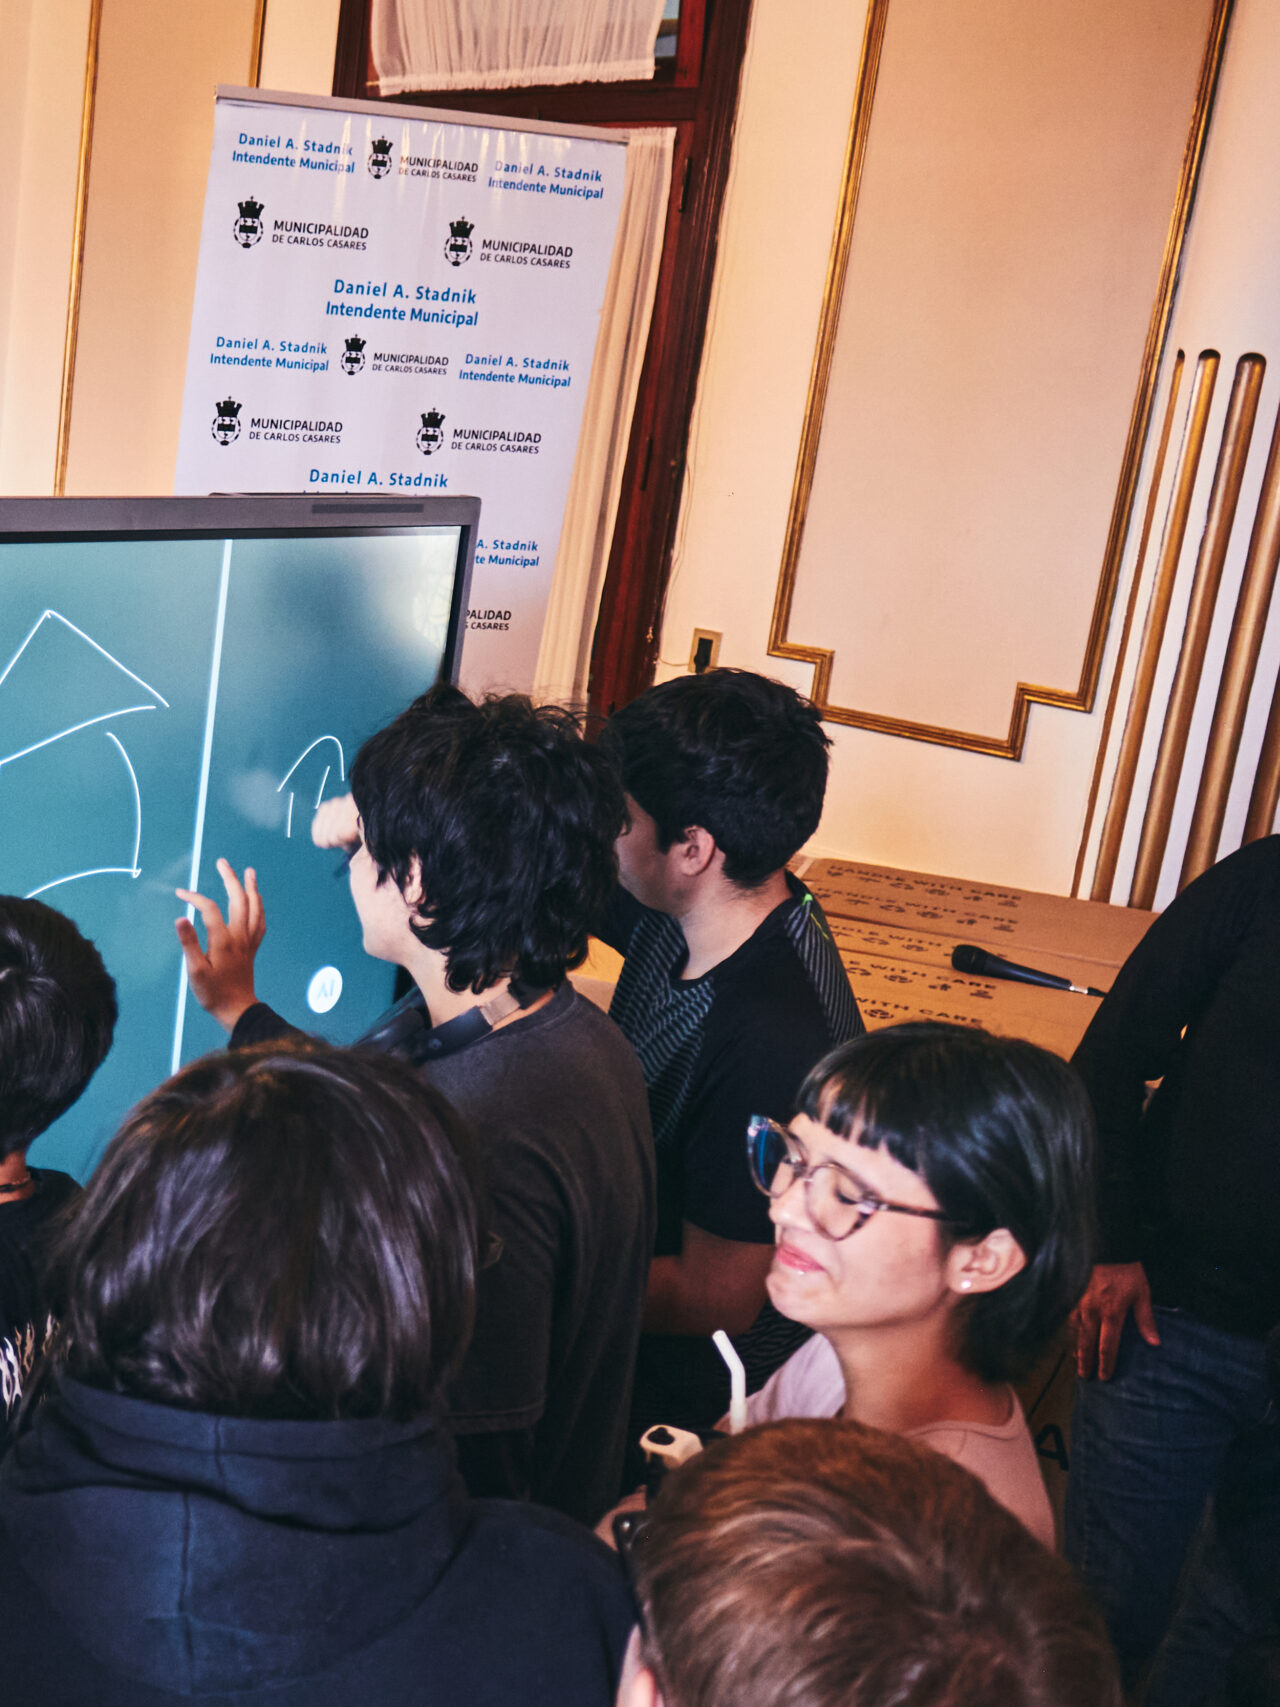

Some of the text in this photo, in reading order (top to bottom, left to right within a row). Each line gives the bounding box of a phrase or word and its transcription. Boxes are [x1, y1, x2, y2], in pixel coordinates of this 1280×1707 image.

[239, 133, 280, 147] Daniel
[285, 138, 298, 150] A.
[232, 150, 355, 173] Intendente Municipal
[400, 156, 478, 172] MUNICIPALIDAD
[411, 168, 440, 178] CARLOS
[442, 172, 476, 182] CASARES
[495, 160, 602, 182] Daniel A. Stadnik
[488, 177, 603, 200] Intendente Municipal
[274, 220, 368, 239] MUNICIPALIDAD
[272, 234, 367, 250] DE CARLOS CASARES
[482, 239, 573, 258] MUNICIPALIDAD
[480, 252, 571, 269] DE CARLOS CASARES
[334, 279, 477, 304] Daniel A. Stadnik
[326, 301, 479, 328] Intendente Municipal
[216, 336, 327, 354] Daniel A. Stadnik
[210, 353, 329, 373] Intendente Municipal
[373, 352, 449, 366] MUNICIPALIDAD
[465, 353, 570, 372] Daniel A. Stadnik
[372, 364, 447, 376] DE CARLOS CASARES
[459, 370, 571, 388] Intendente Municipal
[250, 418, 343, 433] MUNICIPALIDAD
[249, 431, 341, 444] DE CARLOS CASARES
[453, 429, 542, 444] MUNICIPALIDAD
[451, 441, 539, 455] DE CARLOS CASARES
[309, 469, 448, 488] Daniel A. Stadnik
[476, 539, 538, 551] A. Stadnik
[488, 554, 540, 568] Municipal
[471, 621, 510, 631] CASARES
[829, 865, 1022, 901] HANDLE WITH CARE
[905, 901, 957, 914] WITH
[964, 911, 1019, 924] CARE
[888, 933, 942, 947] WITH
[871, 963, 927, 978] WITH
[936, 975, 997, 990] CARE
[919, 1009, 983, 1023] CARE
